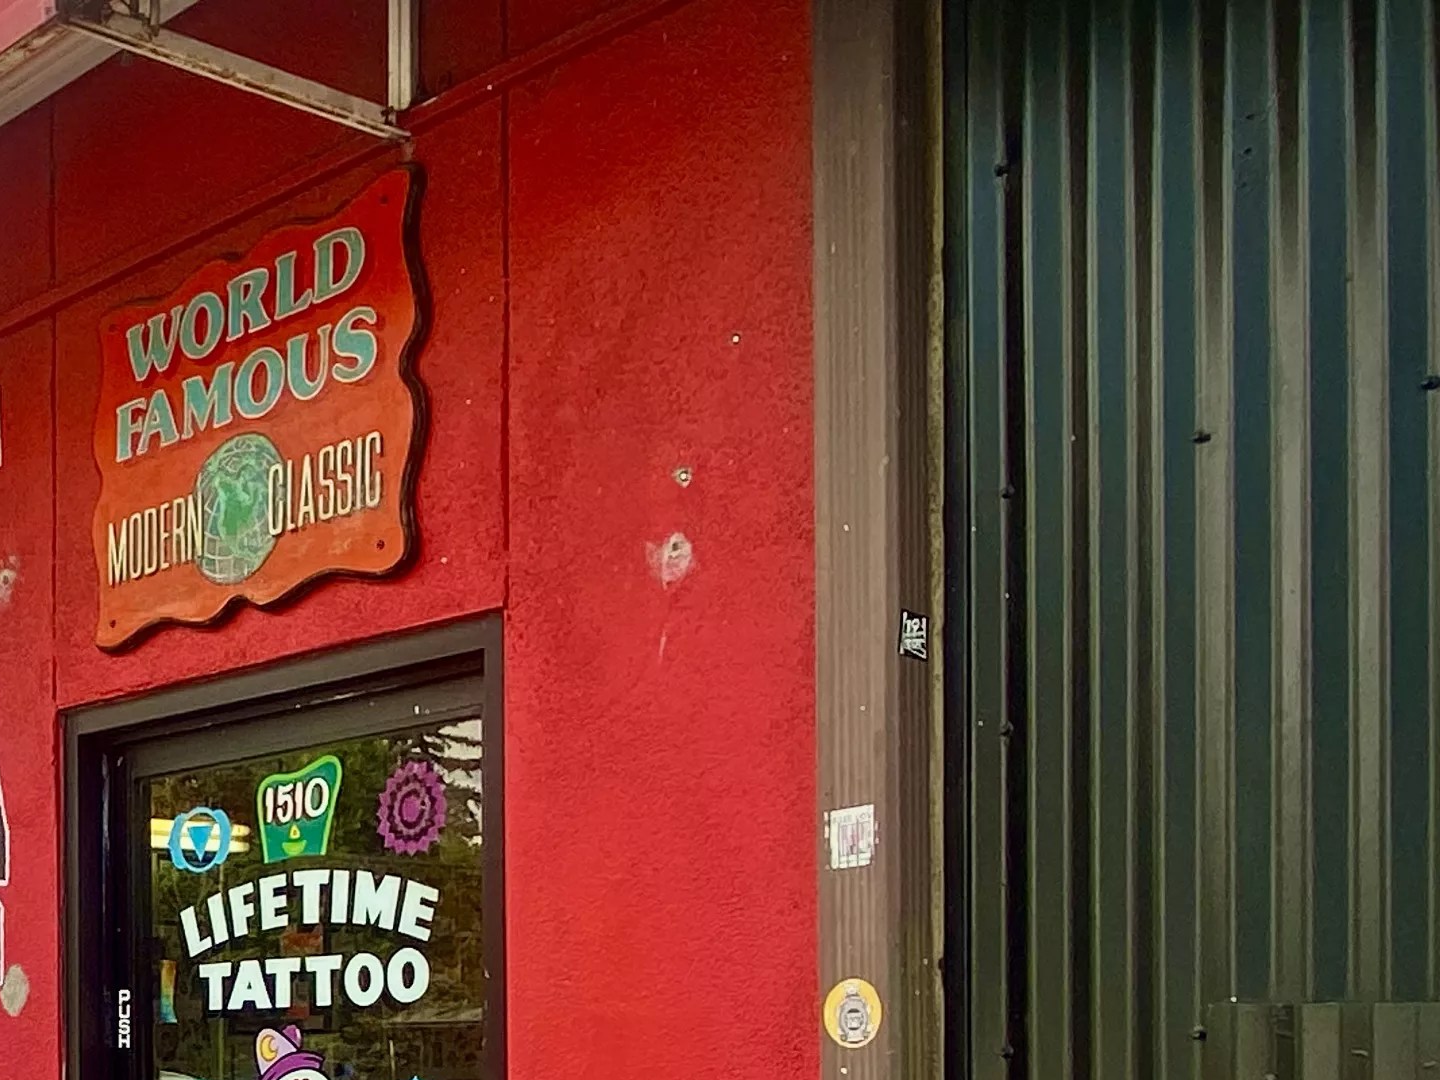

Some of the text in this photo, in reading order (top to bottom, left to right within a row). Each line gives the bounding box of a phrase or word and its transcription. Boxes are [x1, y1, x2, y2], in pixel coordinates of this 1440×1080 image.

[126, 227, 366, 382] WORLD
[115, 305, 379, 463] FAMOUS
[107, 430, 383, 586] MODERN CLASSIC
[265, 777, 329, 824] 1510
[179, 869, 440, 958] LIFETIME
[117, 990, 131, 1049] PUSH
[198, 947, 431, 1012] TATTOO
